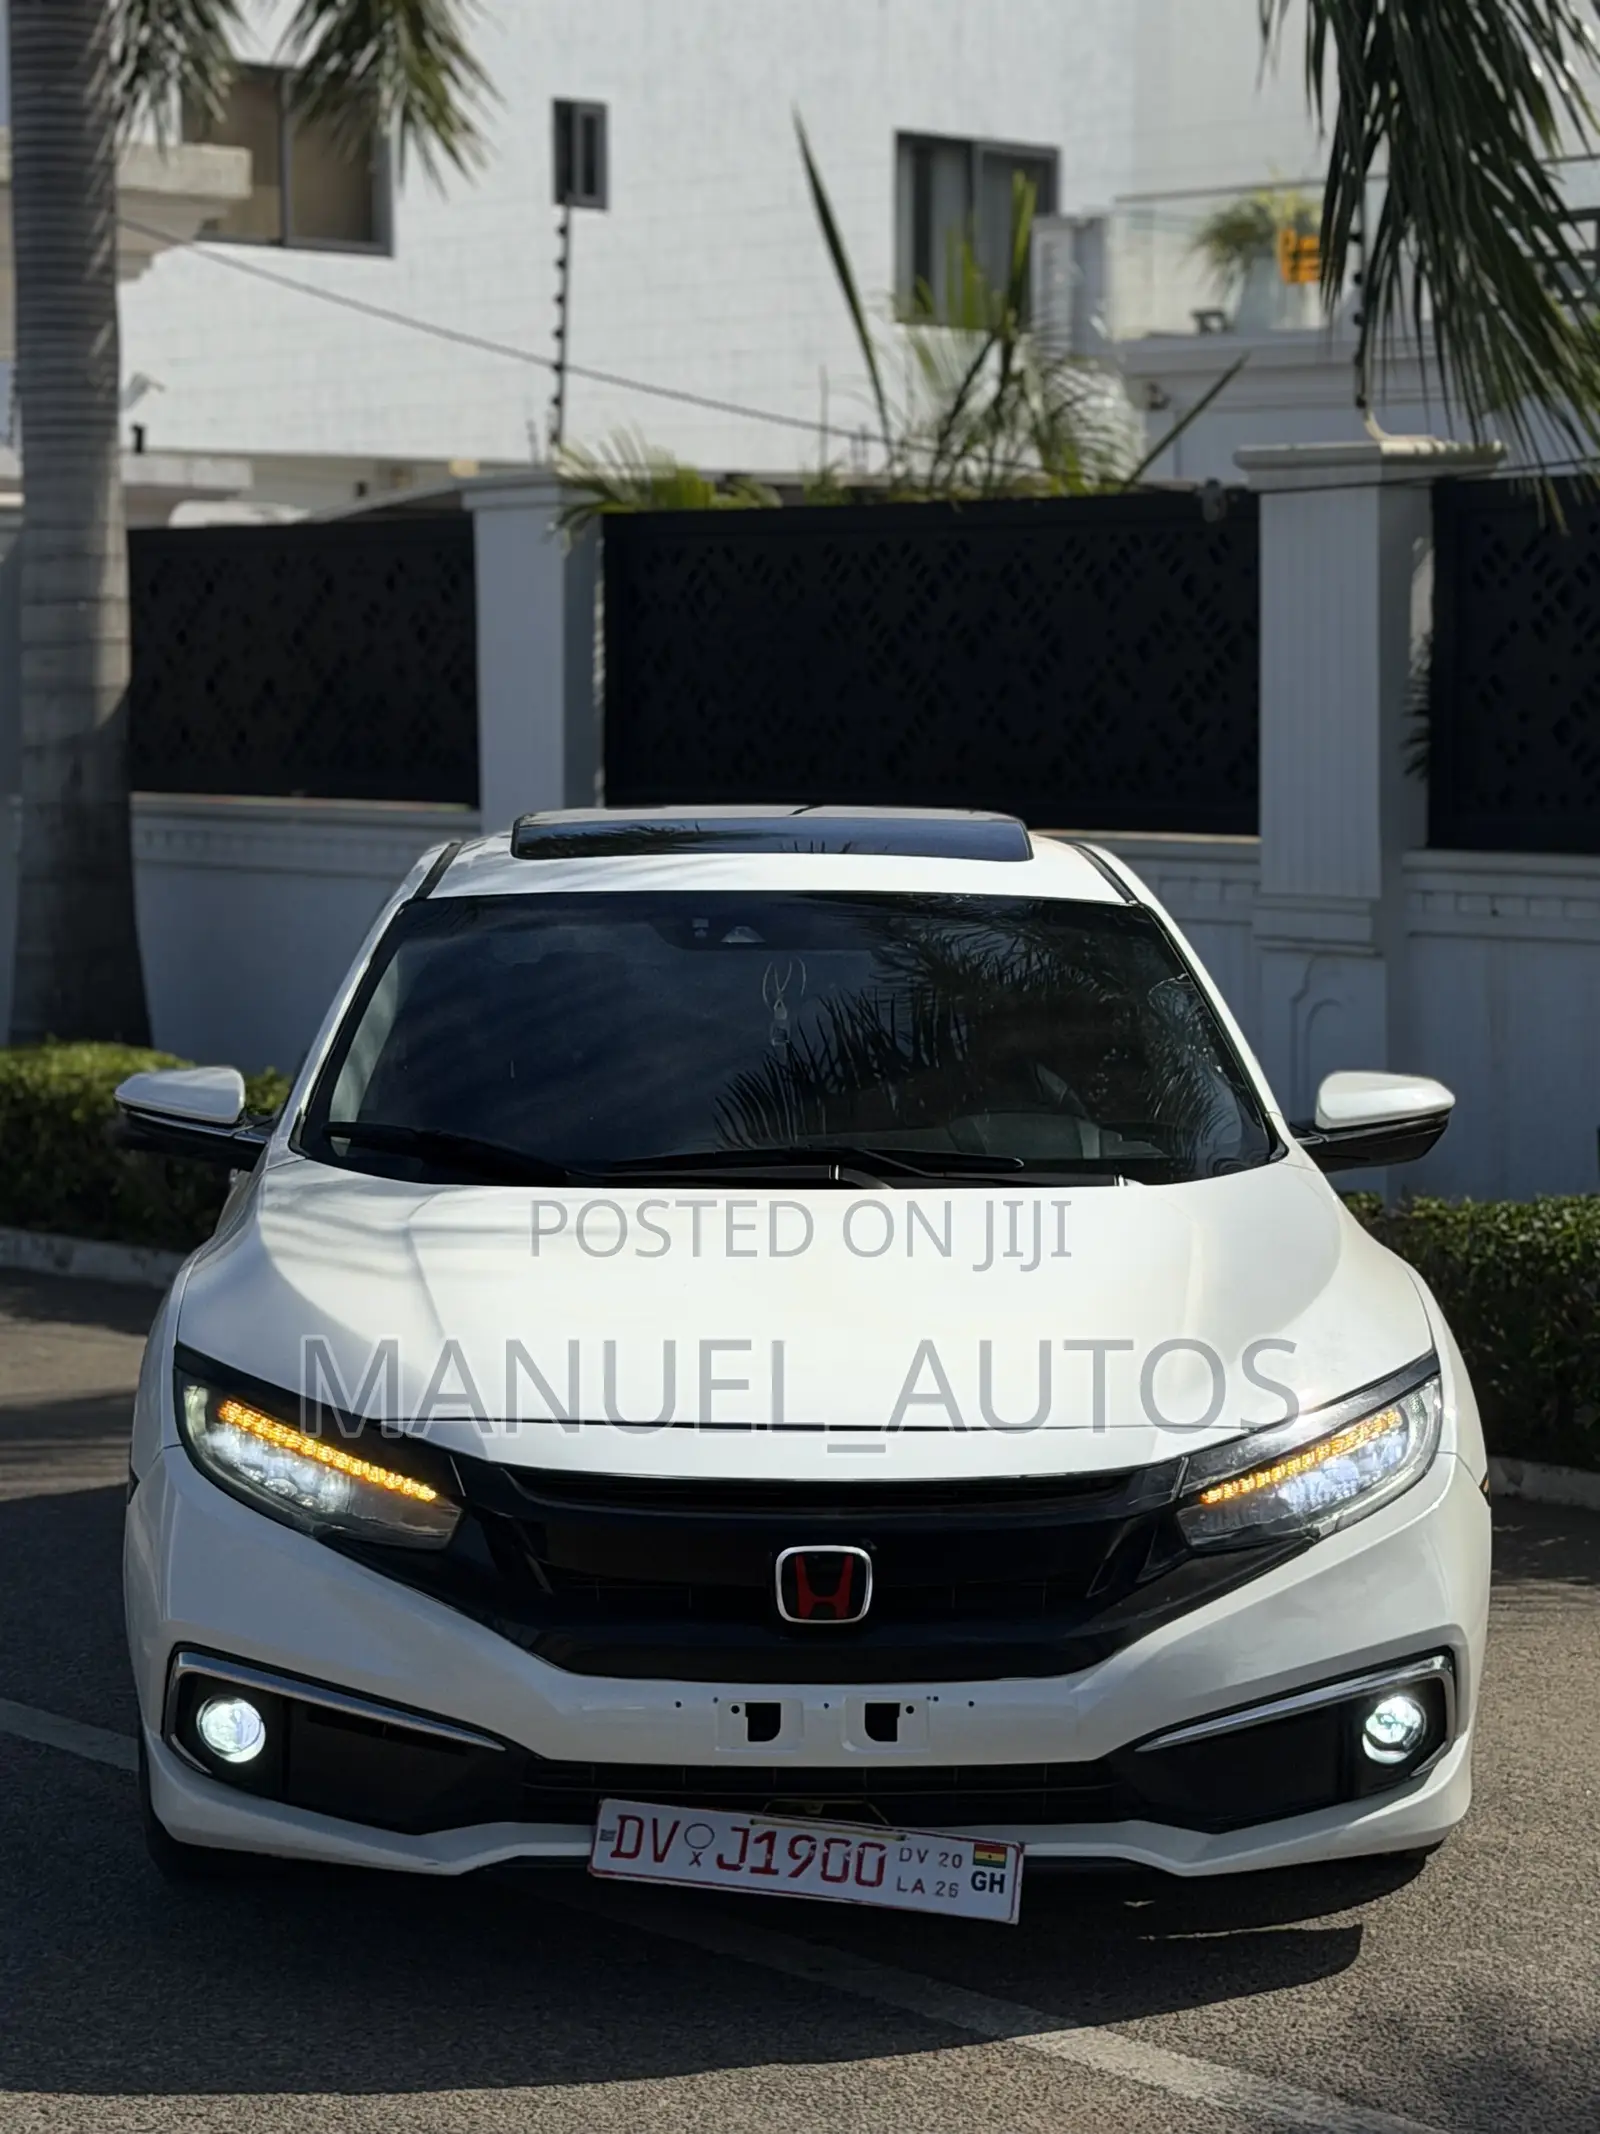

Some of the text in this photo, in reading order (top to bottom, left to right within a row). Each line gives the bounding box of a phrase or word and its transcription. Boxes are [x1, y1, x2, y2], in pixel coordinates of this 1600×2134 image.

[610, 1814, 681, 1863] DV
[716, 1826, 888, 1888] J1900
[898, 1846, 963, 1869] DV 20
[896, 1876, 926, 1895] LA
[970, 1870, 1006, 1895] GH
